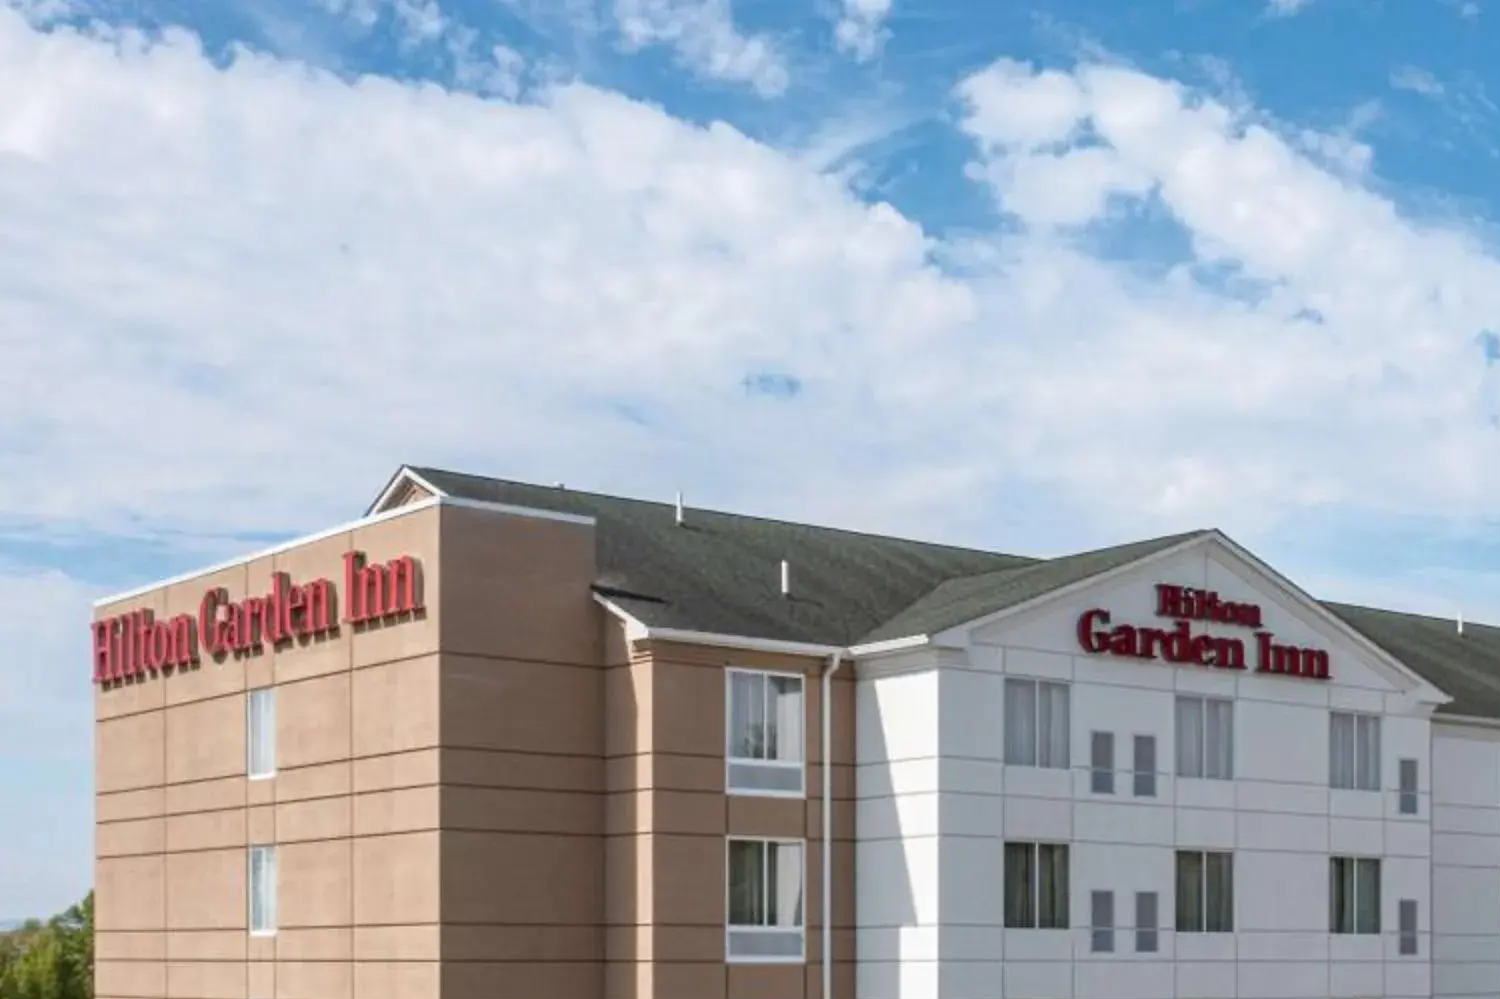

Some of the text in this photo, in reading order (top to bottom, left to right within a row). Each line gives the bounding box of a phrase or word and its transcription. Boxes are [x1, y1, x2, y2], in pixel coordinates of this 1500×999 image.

[92, 550, 416, 684] Hilton Garden Inn
[1154, 583, 1262, 628] Hilton
[1077, 607, 1333, 680] Garden Inn
